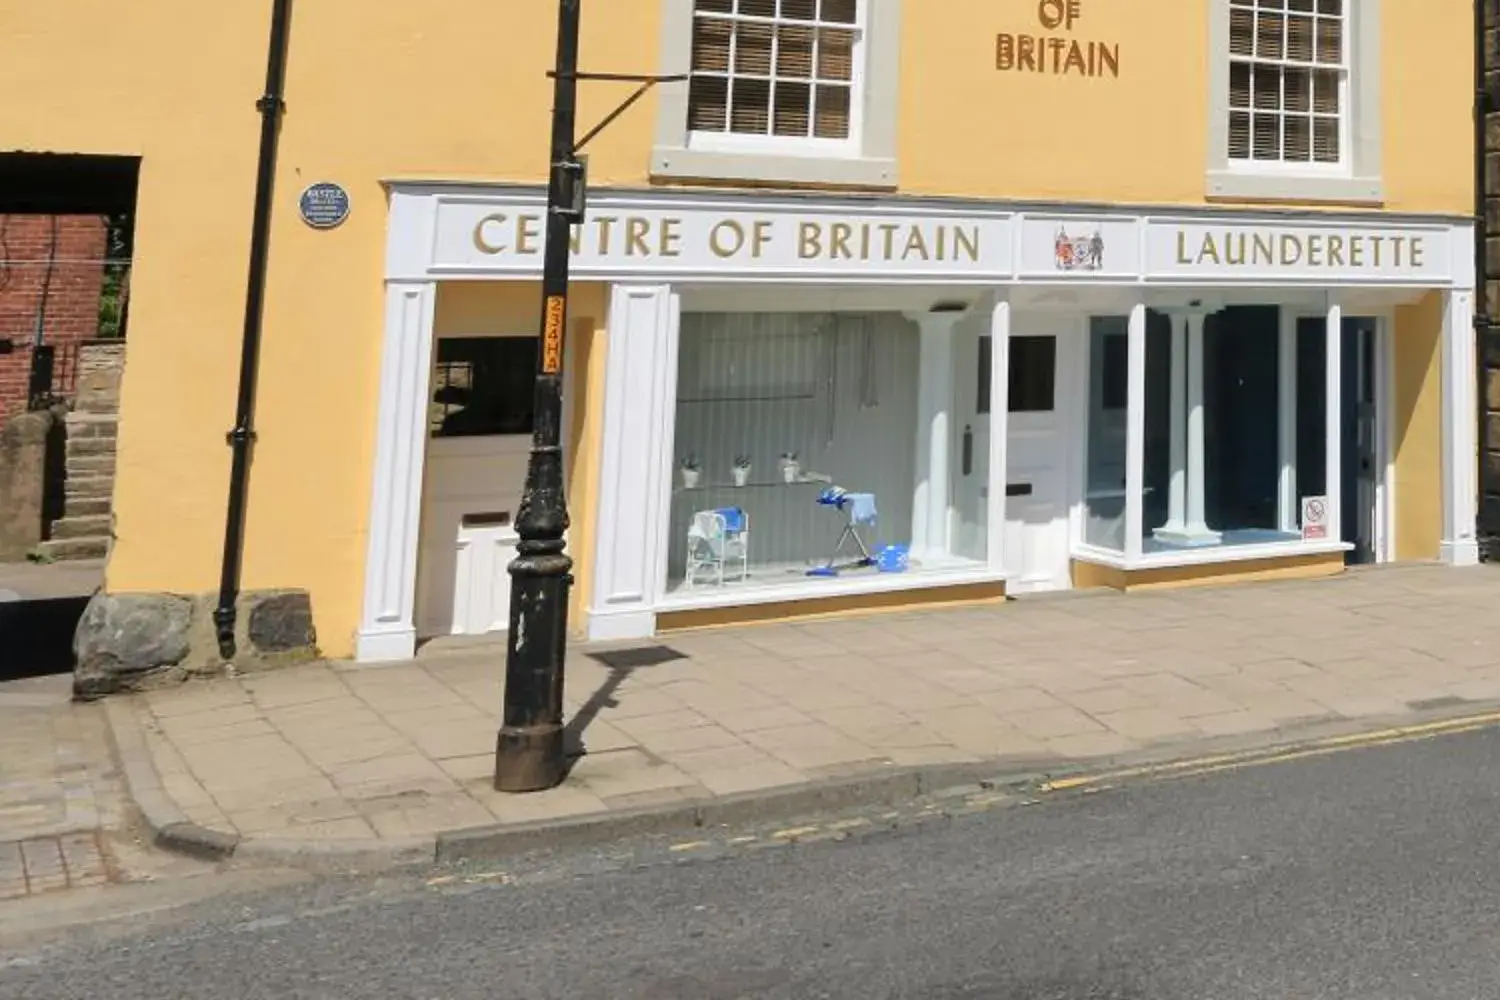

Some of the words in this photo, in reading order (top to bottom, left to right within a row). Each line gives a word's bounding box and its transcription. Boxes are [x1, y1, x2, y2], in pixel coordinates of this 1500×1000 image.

[996, 33, 1119, 78] BRITAIN
[709, 217, 773, 258] OF
[798, 221, 980, 261] BRITAIN
[1176, 230, 1424, 266] LAUNDERETTE
